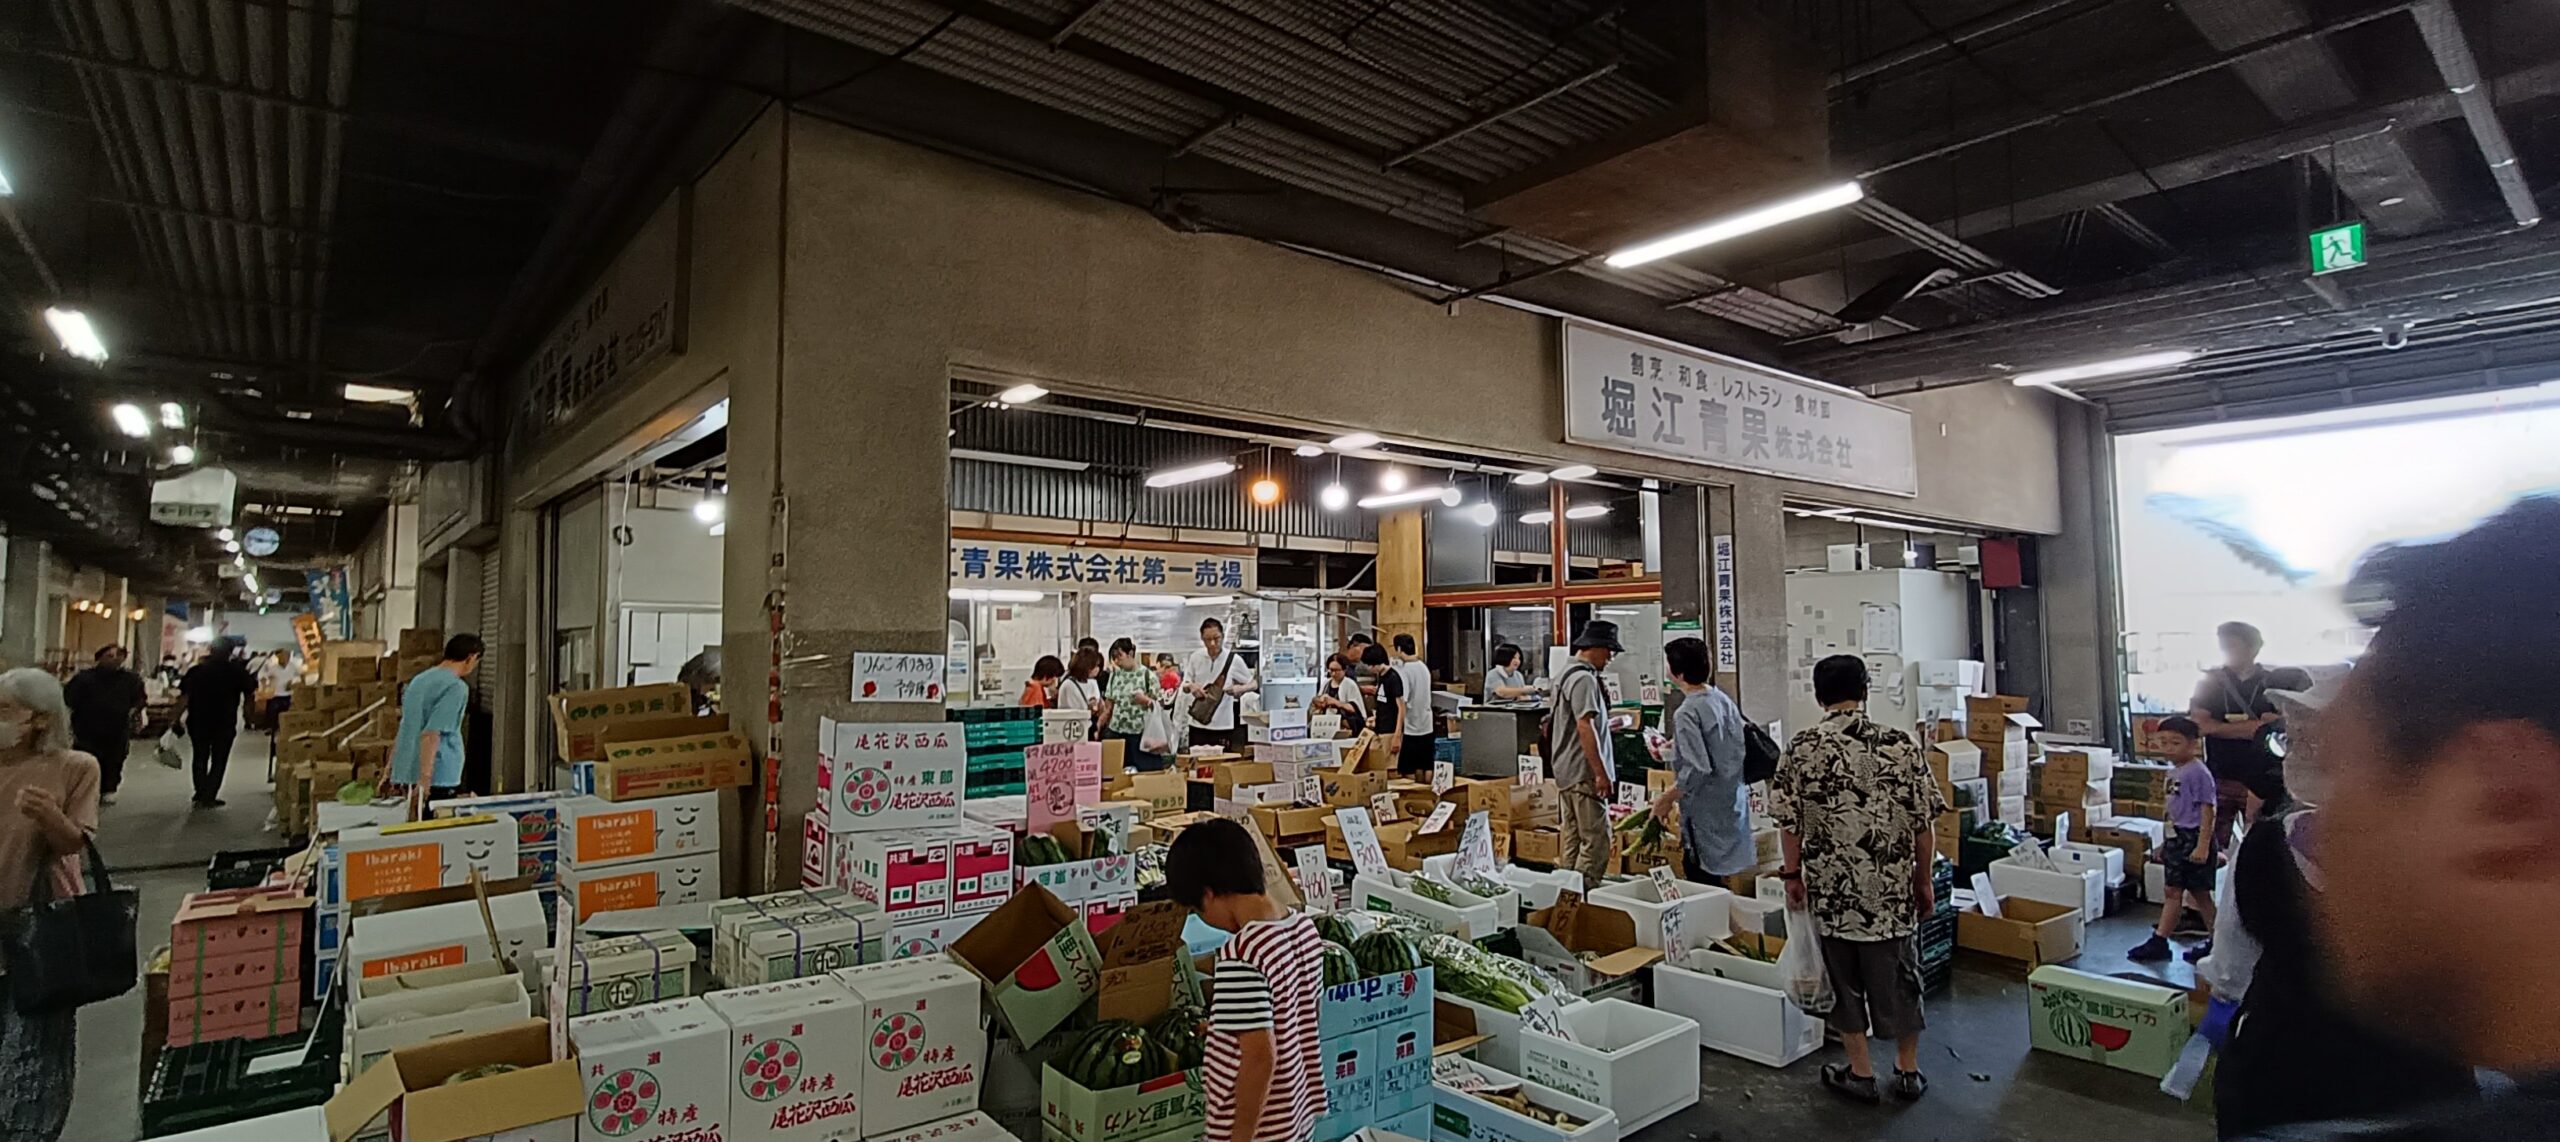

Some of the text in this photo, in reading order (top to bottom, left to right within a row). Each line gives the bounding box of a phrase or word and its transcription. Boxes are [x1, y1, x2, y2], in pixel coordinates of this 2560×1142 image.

[1601, 375, 1853, 470] 堀江青果株式会社
[1716, 542, 1735, 665] 堀江青果株式会社
[855, 732, 949, 751] 尾花沢西瓜
[920, 769, 954, 785] 東部
[889, 791, 956, 811] 尾花沢西瓜
[592, 814, 640, 831] Ibaraki
[365, 848, 422, 866] Ibaraki
[888, 852, 910, 865] 共選
[595, 877, 642, 894] Ibaraki
[383, 952, 445, 974] Ibaraki
[871, 998, 927, 1020] 共 選
[741, 1023, 804, 1047] 共 選
[591, 1051, 661, 1078] 共 選
[923, 1045, 956, 1065] 特産
[799, 1072, 836, 1094] 特産
[896, 1063, 974, 1099] 尾花沢西瓜
[657, 1103, 699, 1127] 特産
[769, 1092, 857, 1131] 尾花沢西瓜
